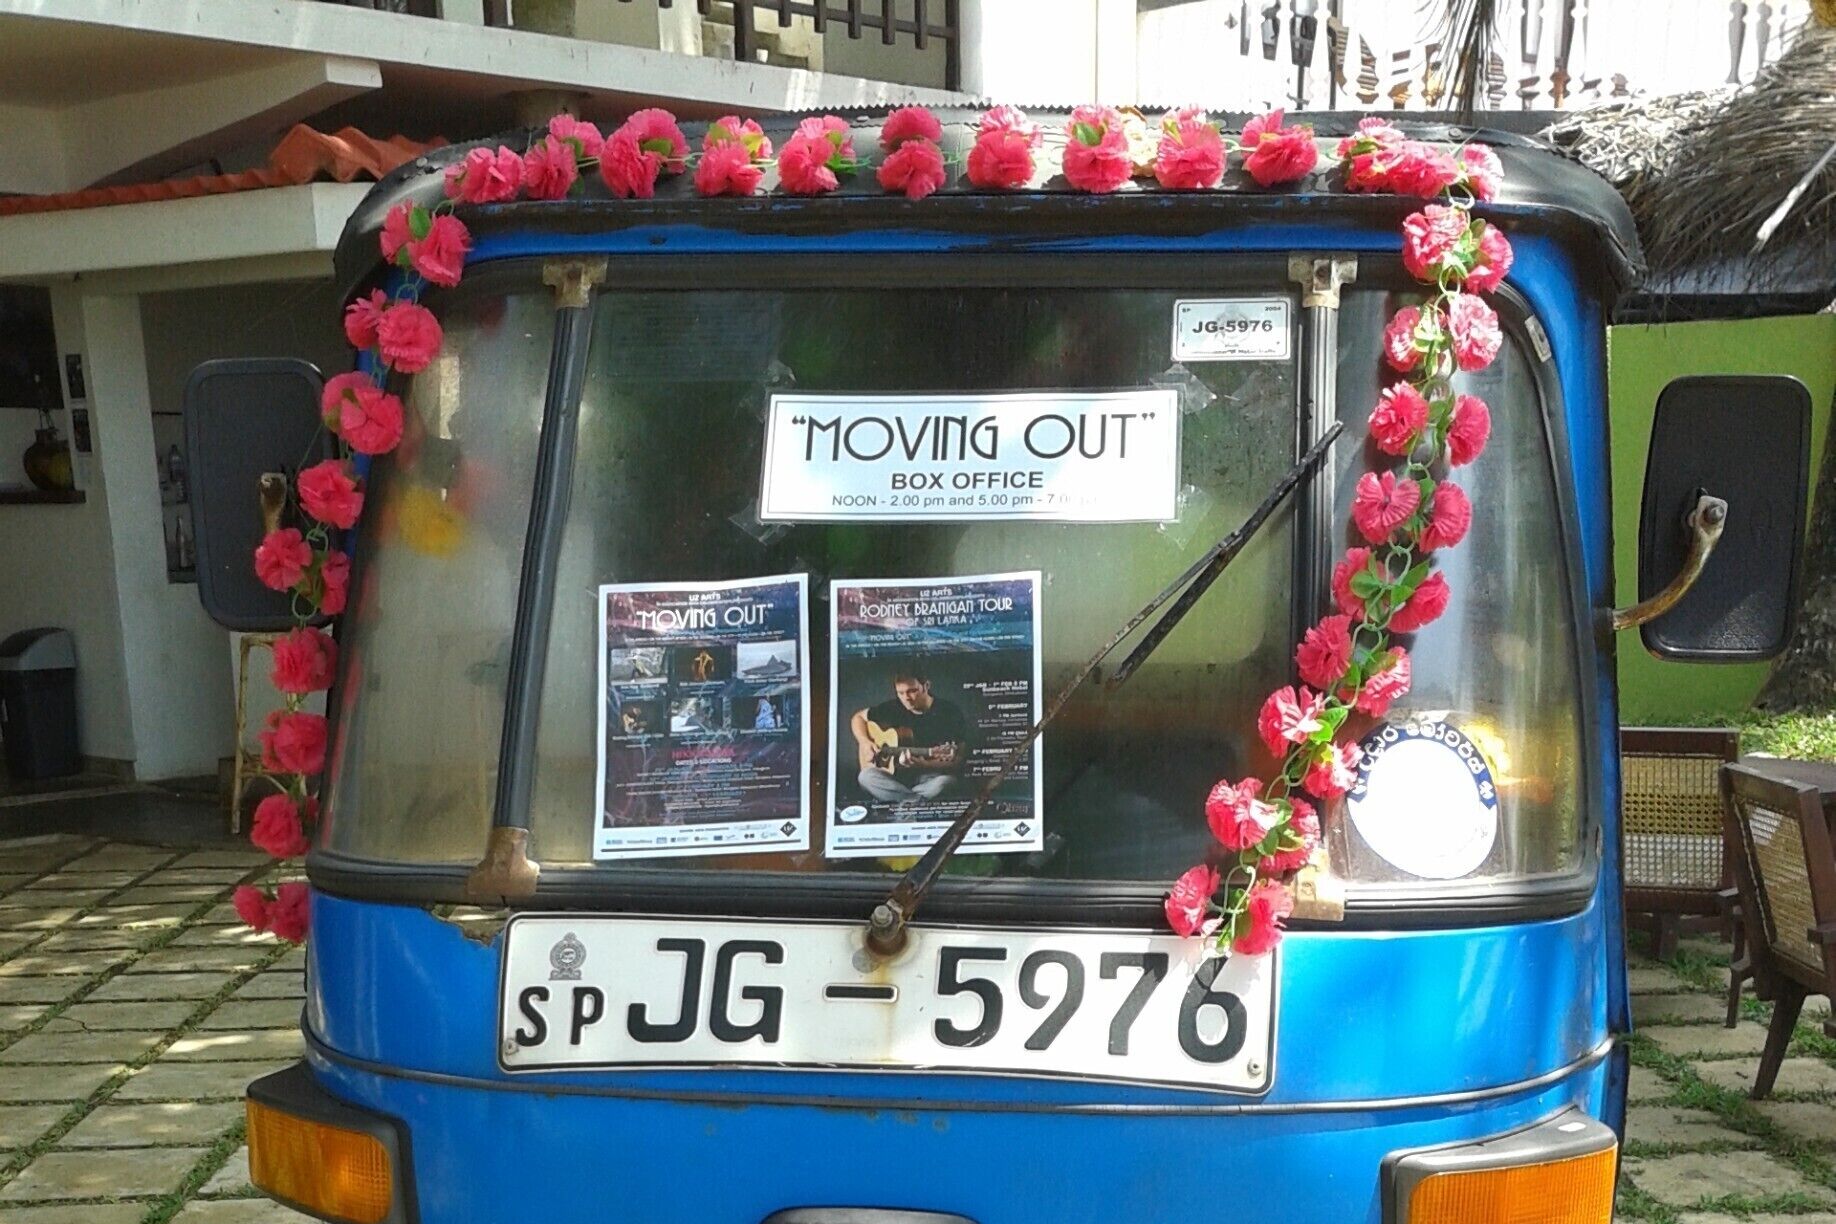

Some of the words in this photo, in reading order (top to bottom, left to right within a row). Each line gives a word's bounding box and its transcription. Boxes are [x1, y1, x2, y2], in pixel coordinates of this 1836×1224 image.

[1192, 320, 1273, 333] JG-5976
[791, 414, 1000, 462] “MOVING
[891, 472, 944, 490] BOX
[951, 470, 1044, 489] OFFICE
[832, 495, 878, 507] NOON
[890, 495, 920, 507] 2.00
[924, 497, 945, 508] pm
[948, 494, 974, 506] and
[978, 494, 1008, 506] 5.00
[1012, 496, 1034, 508] pm
[859, 603, 910, 618] RODNEY
[914, 599, 975, 616] BRANIGAN
[980, 597, 1013, 612] TOUR
[514, 984, 605, 1047] SP
